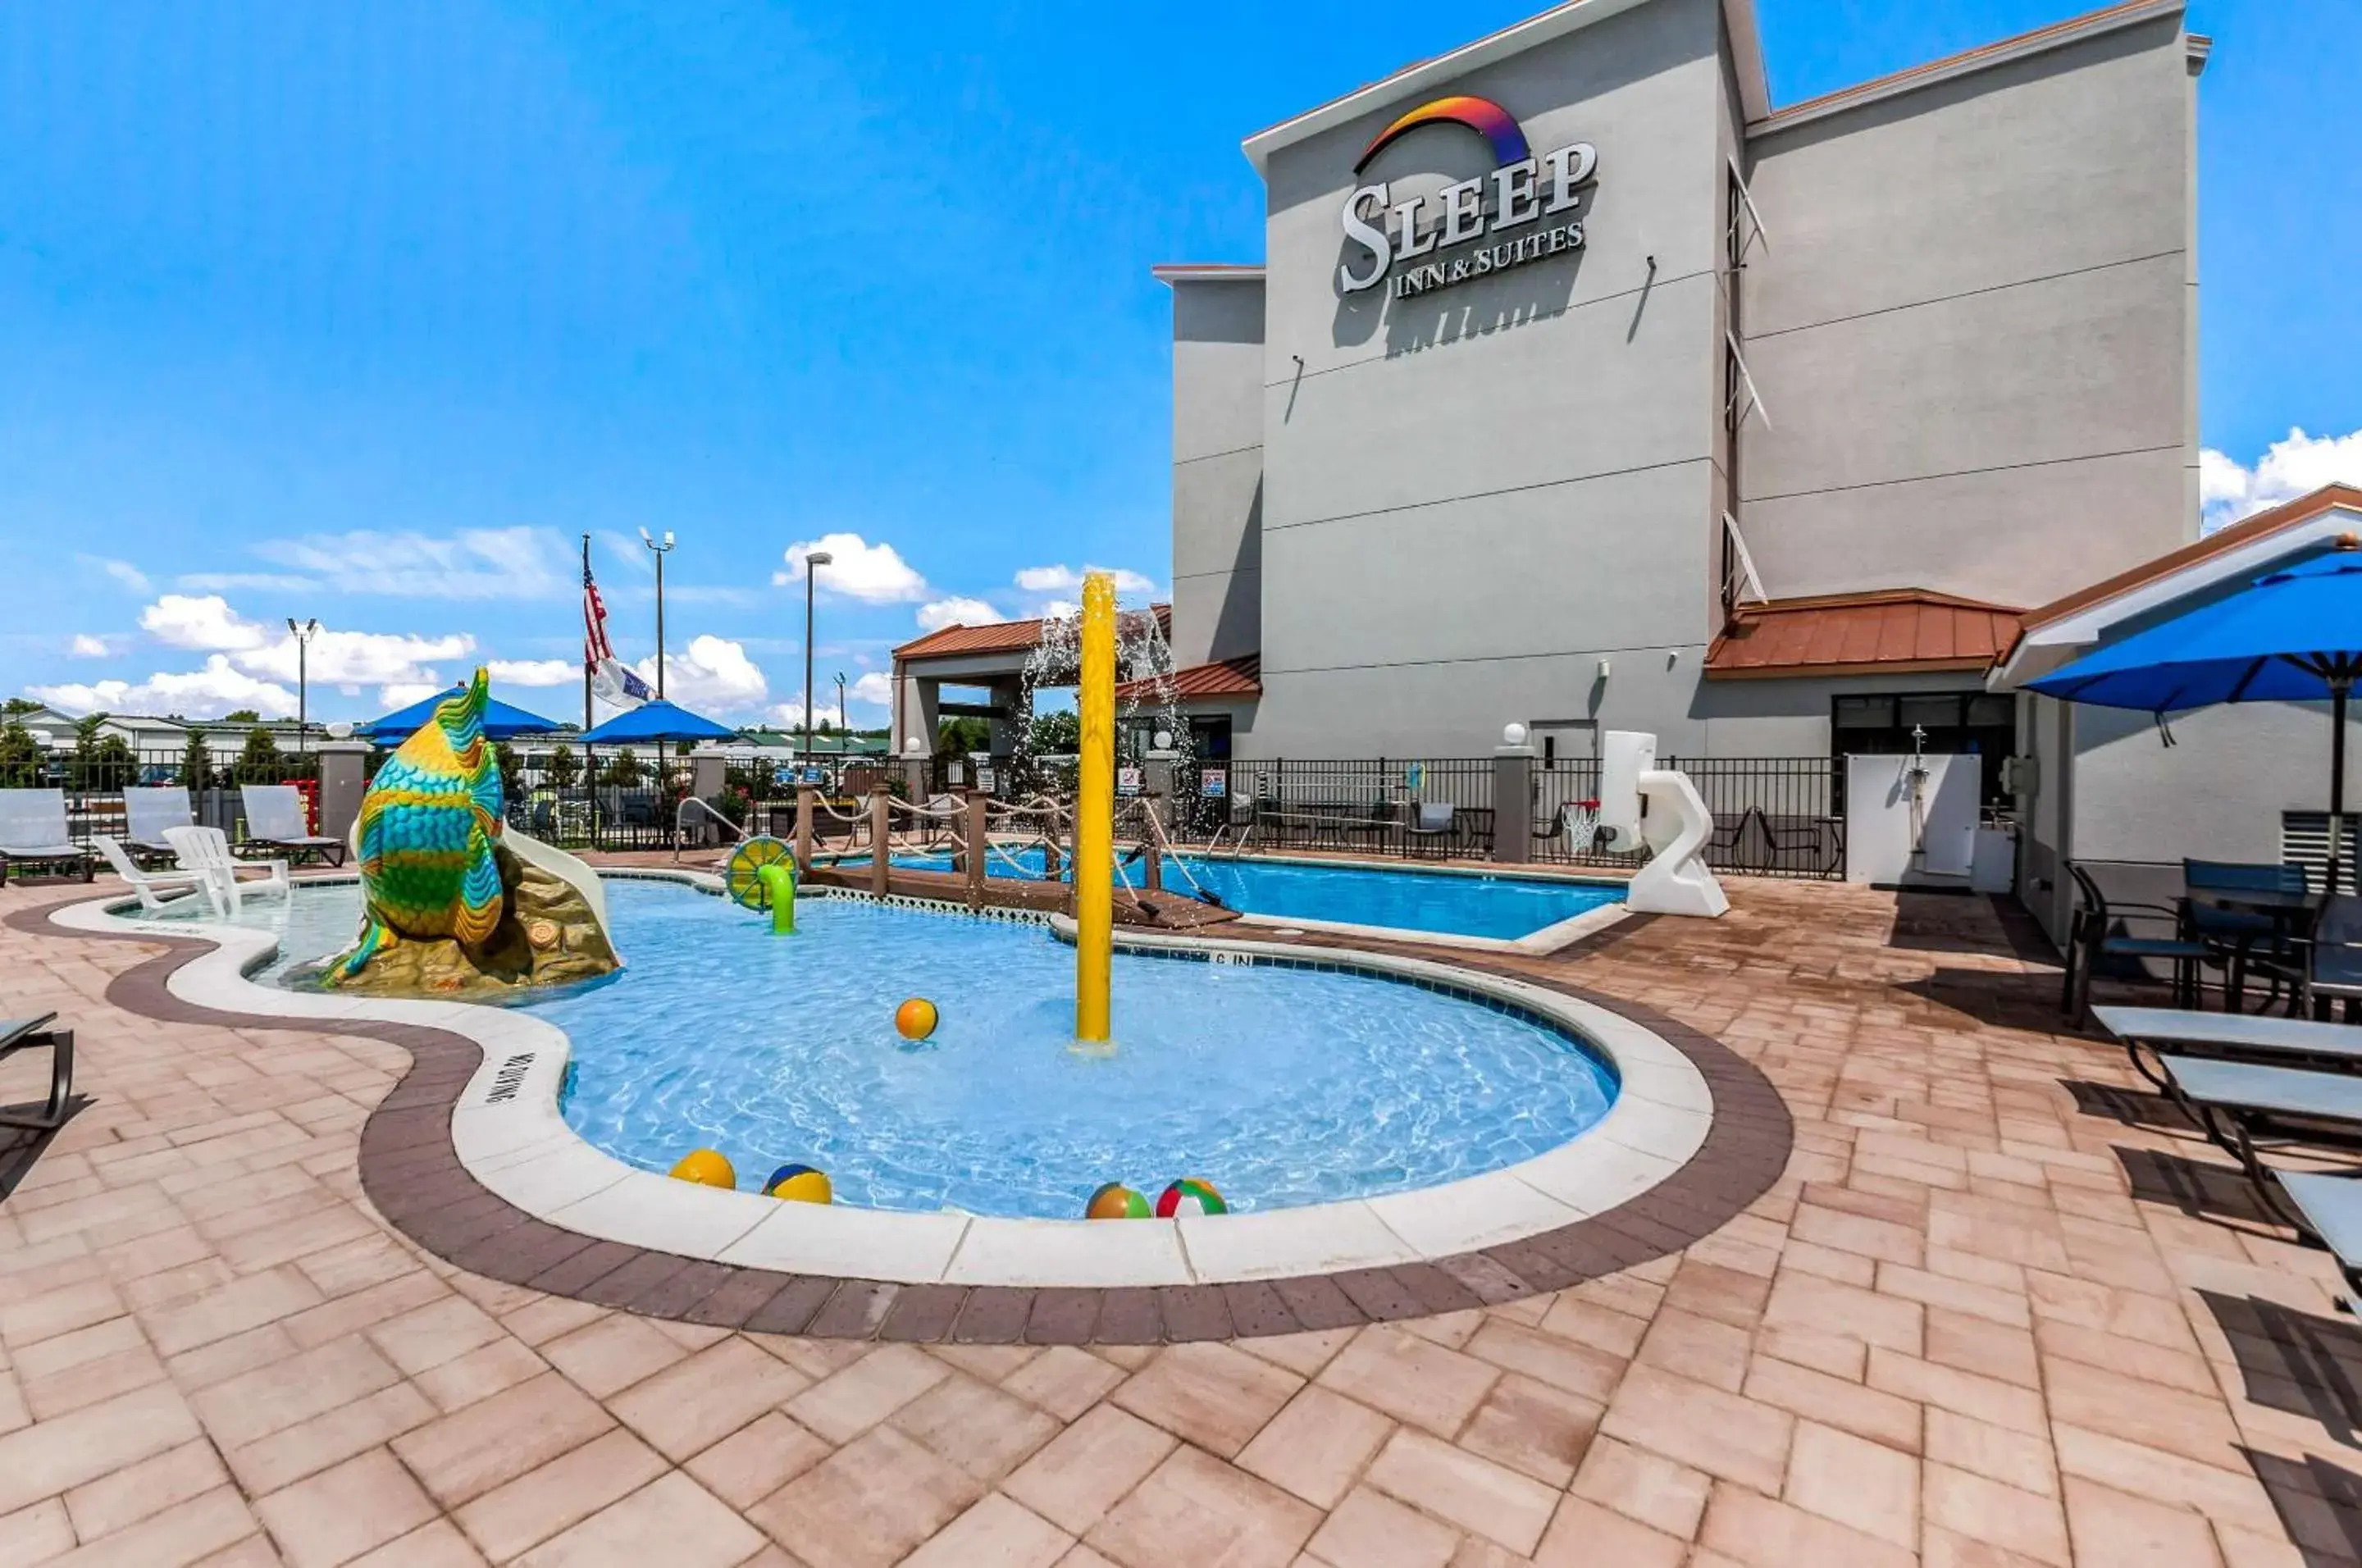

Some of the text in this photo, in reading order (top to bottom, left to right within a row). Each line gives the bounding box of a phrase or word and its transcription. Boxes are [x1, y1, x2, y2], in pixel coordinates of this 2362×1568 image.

[1341, 141, 1598, 293] SLEEP
[1396, 222, 1586, 299] INN & SUITES
[1233, 953, 1251, 966] IN
